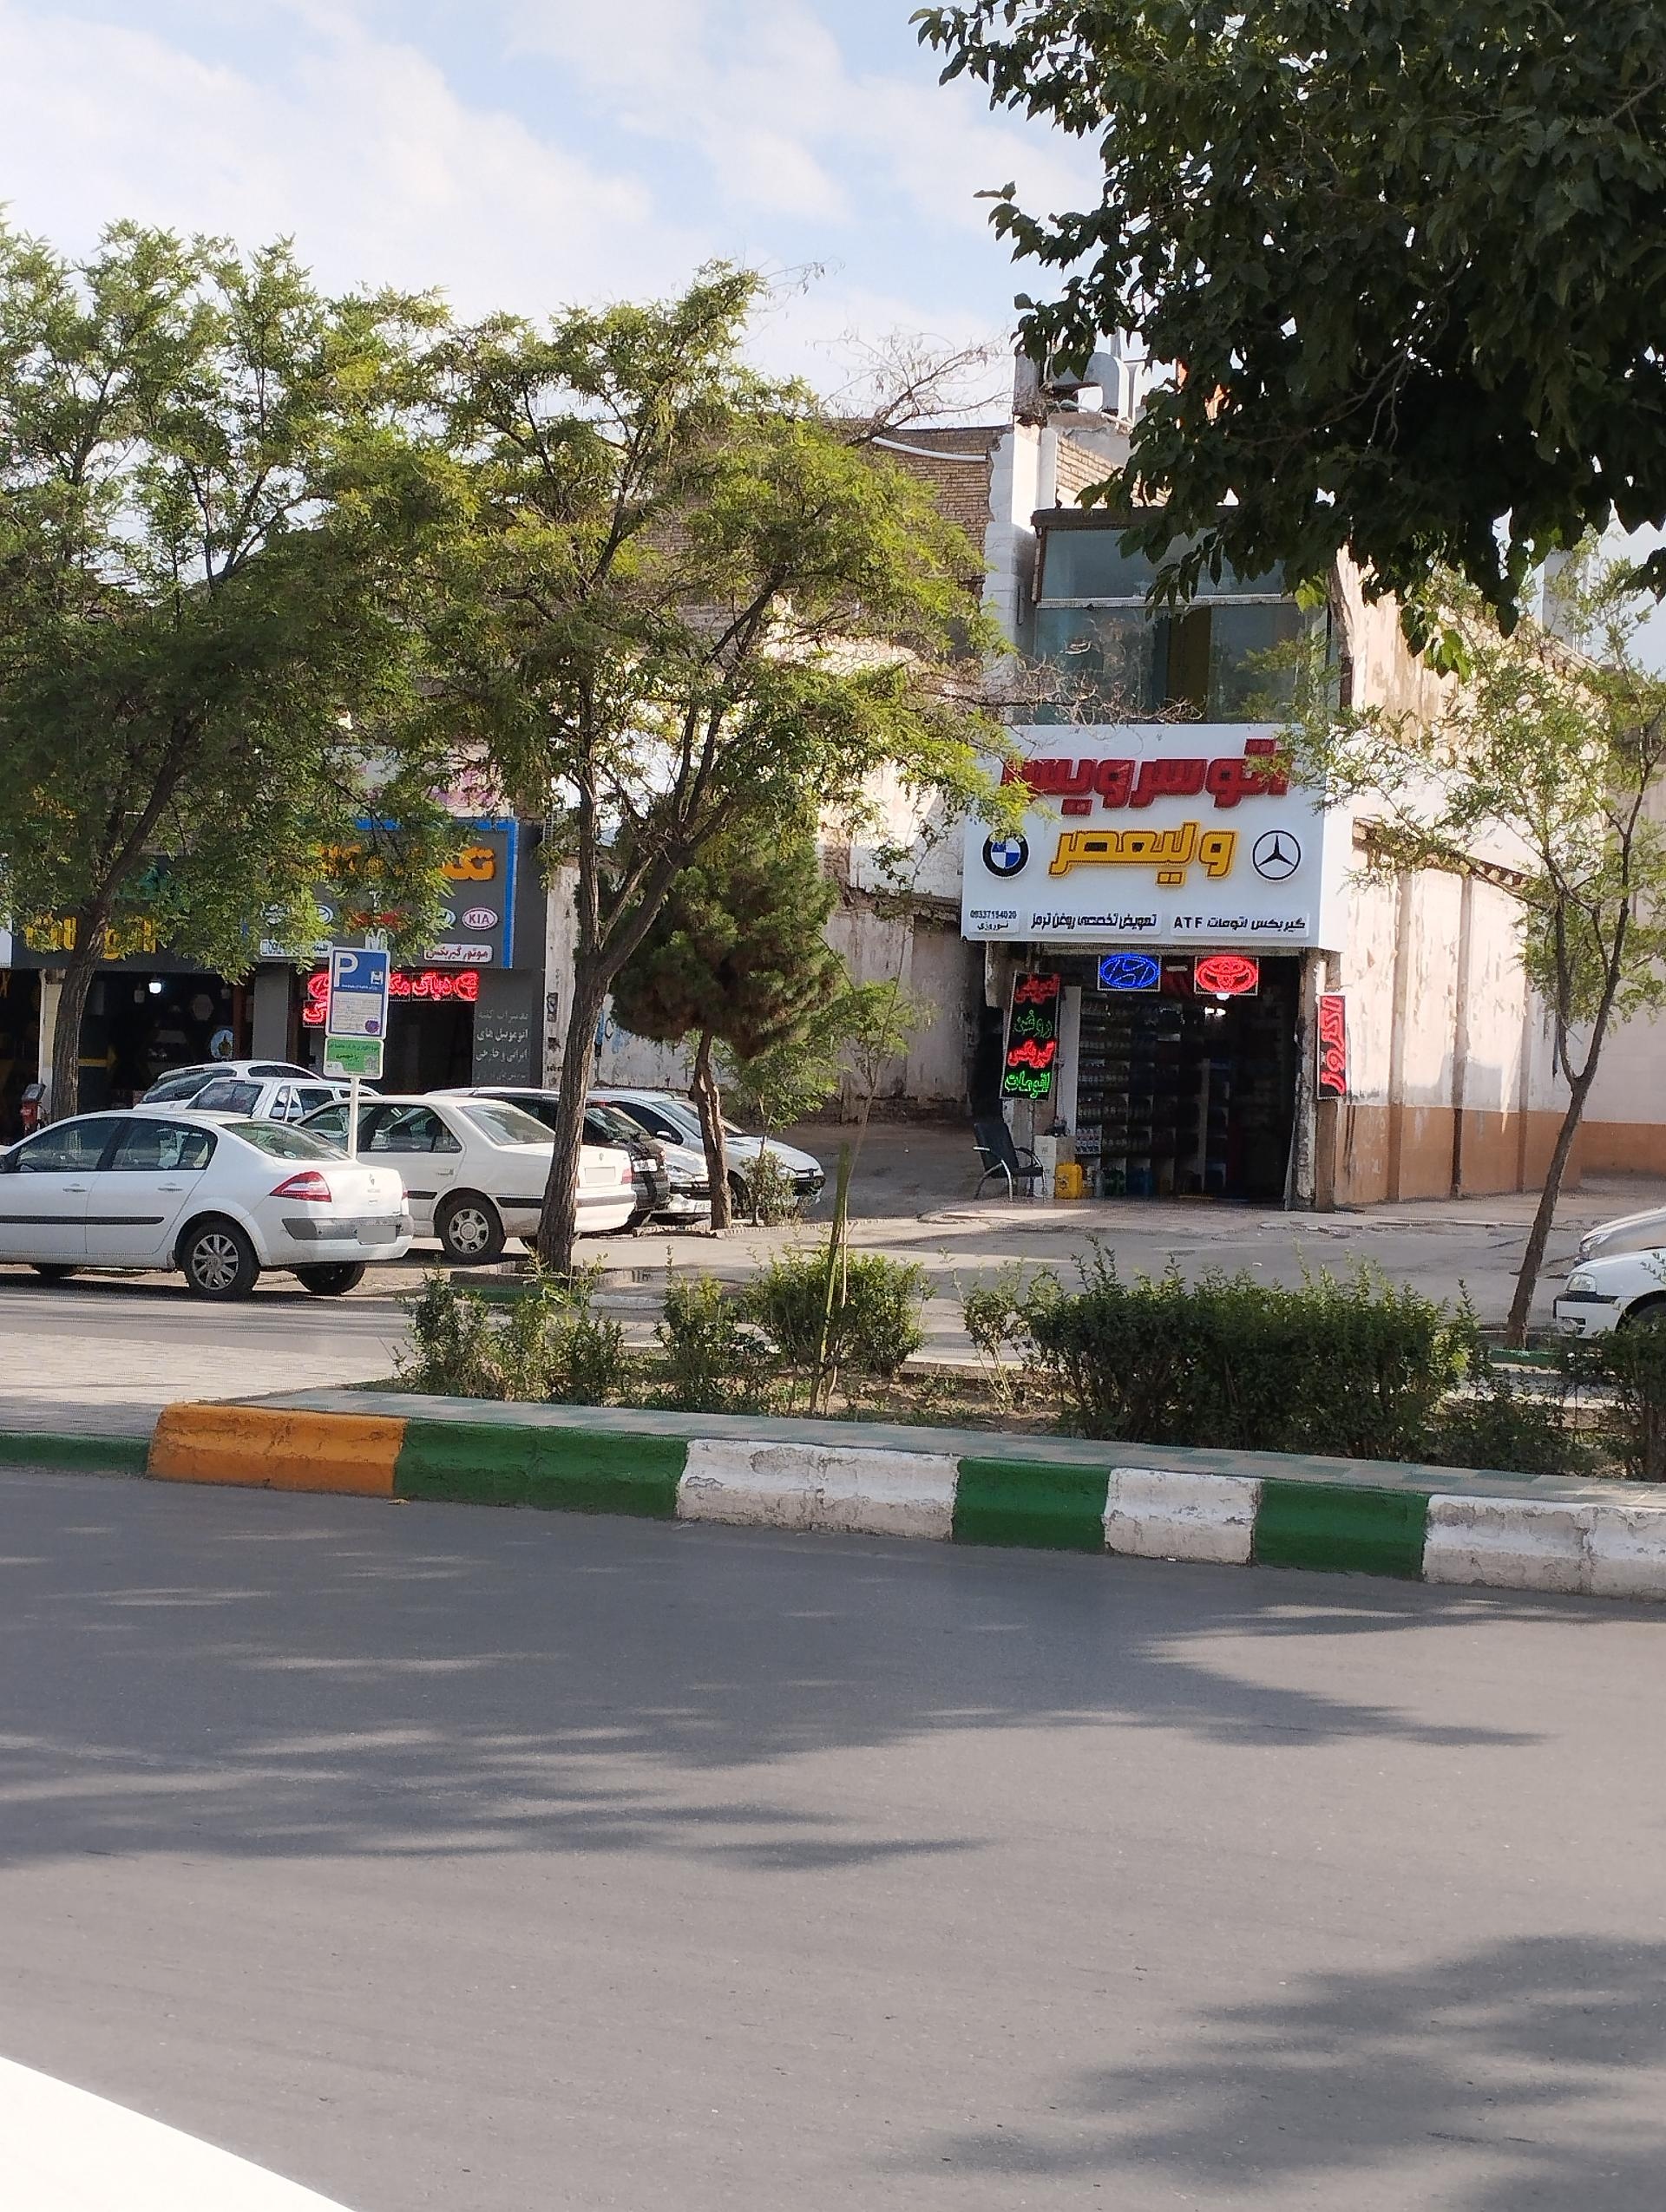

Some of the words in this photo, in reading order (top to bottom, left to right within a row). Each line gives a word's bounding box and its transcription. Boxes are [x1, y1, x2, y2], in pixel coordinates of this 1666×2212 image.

[469, 913, 490, 924] KIA
[1031, 913, 1051, 930] ترمز
[1078, 913, 1118, 927] تخصصی
[1119, 913, 1157, 931] تعویض
[1173, 916, 1203, 929] ATF
[1206, 915, 1249, 931] اتومات
[333, 952, 358, 987] P
[1012, 1009, 1053, 1038] روغن
